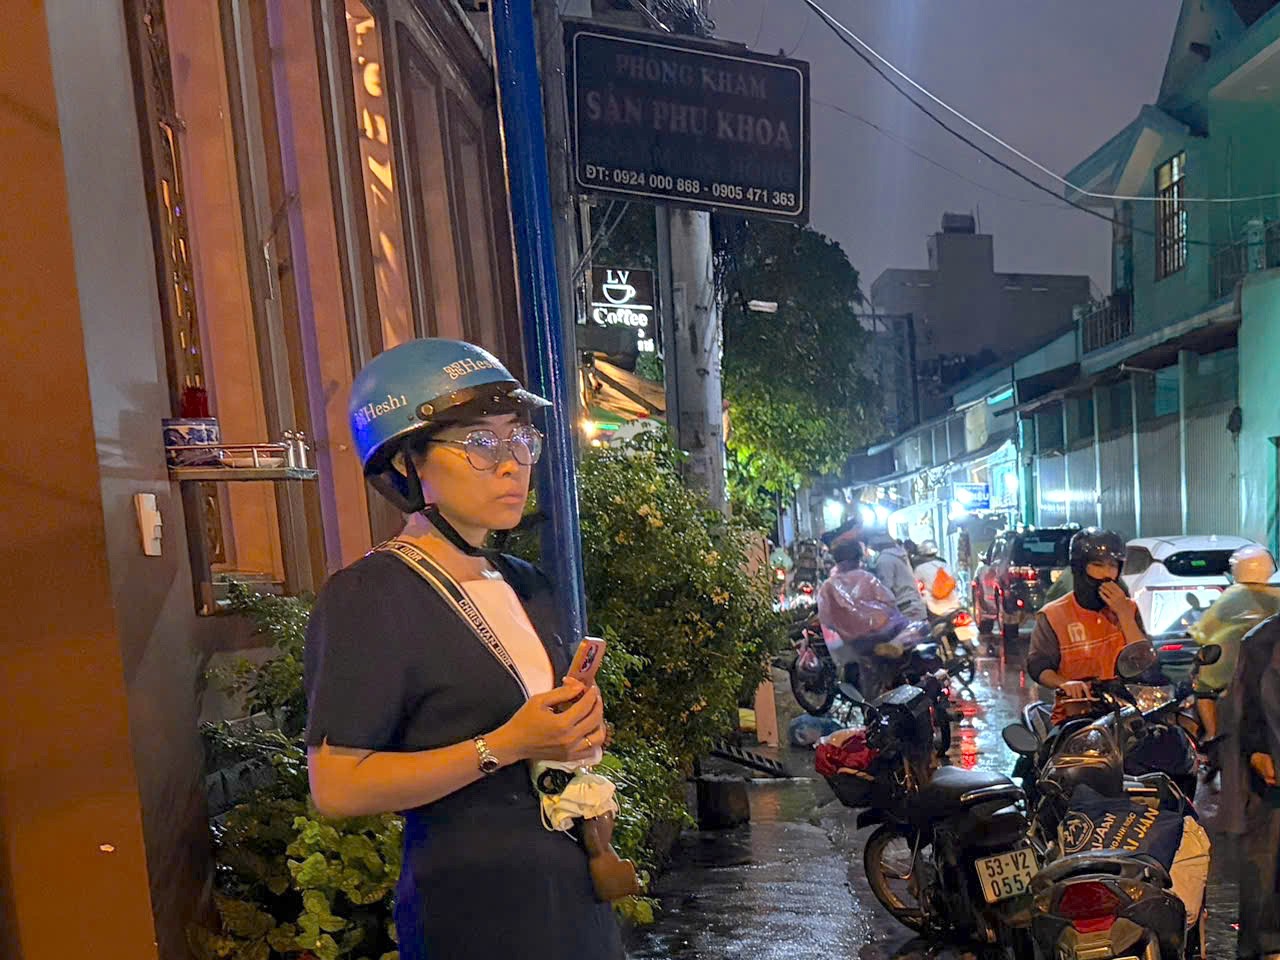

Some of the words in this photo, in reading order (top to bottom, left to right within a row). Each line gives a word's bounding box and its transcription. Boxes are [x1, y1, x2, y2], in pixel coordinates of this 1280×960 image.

[717, 109, 793, 150] KHOA
[586, 165, 610, 182] ĐT:
[613, 168, 646, 186] 0924
[649, 175, 673, 190] 000
[676, 178, 701, 194] 868
[712, 183, 743, 200] 0905
[746, 188, 769, 203] 471
[772, 191, 796, 208] 363
[606, 269, 630, 285] LV
[593, 307, 649, 328] Coffee
[458, 597, 496, 647] CHRISTIAN
[985, 852, 1030, 878] 53-V2
